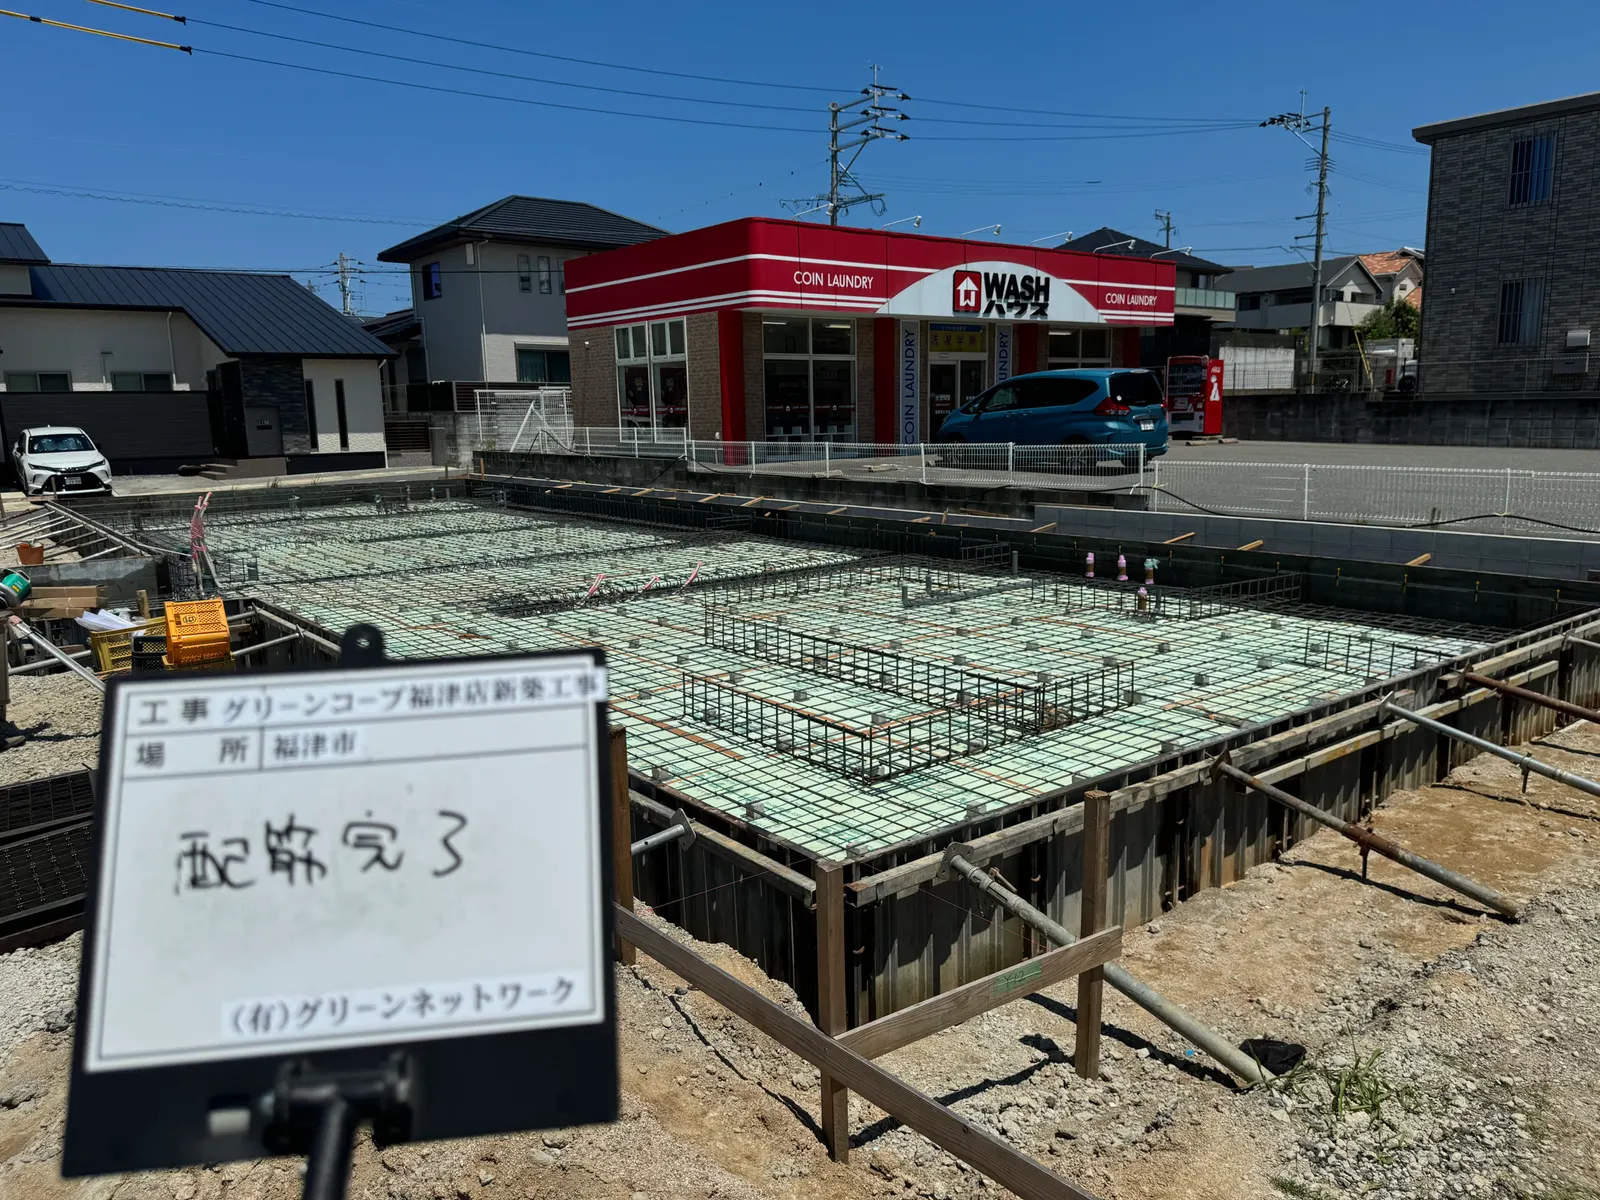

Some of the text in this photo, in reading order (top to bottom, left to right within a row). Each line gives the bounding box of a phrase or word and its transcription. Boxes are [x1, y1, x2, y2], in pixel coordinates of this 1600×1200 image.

[793, 270, 874, 290] COIN LAUNDRY
[983, 272, 1050, 302] WASH
[1105, 292, 1157, 307] COIN LAUNDRY
[905, 330, 914, 398] LAUNDRY
[139, 698, 209, 726] 工事
[272, 731, 359, 758] 福津市
[233, 978, 575, 1034] (有)グリーンネットワーク
